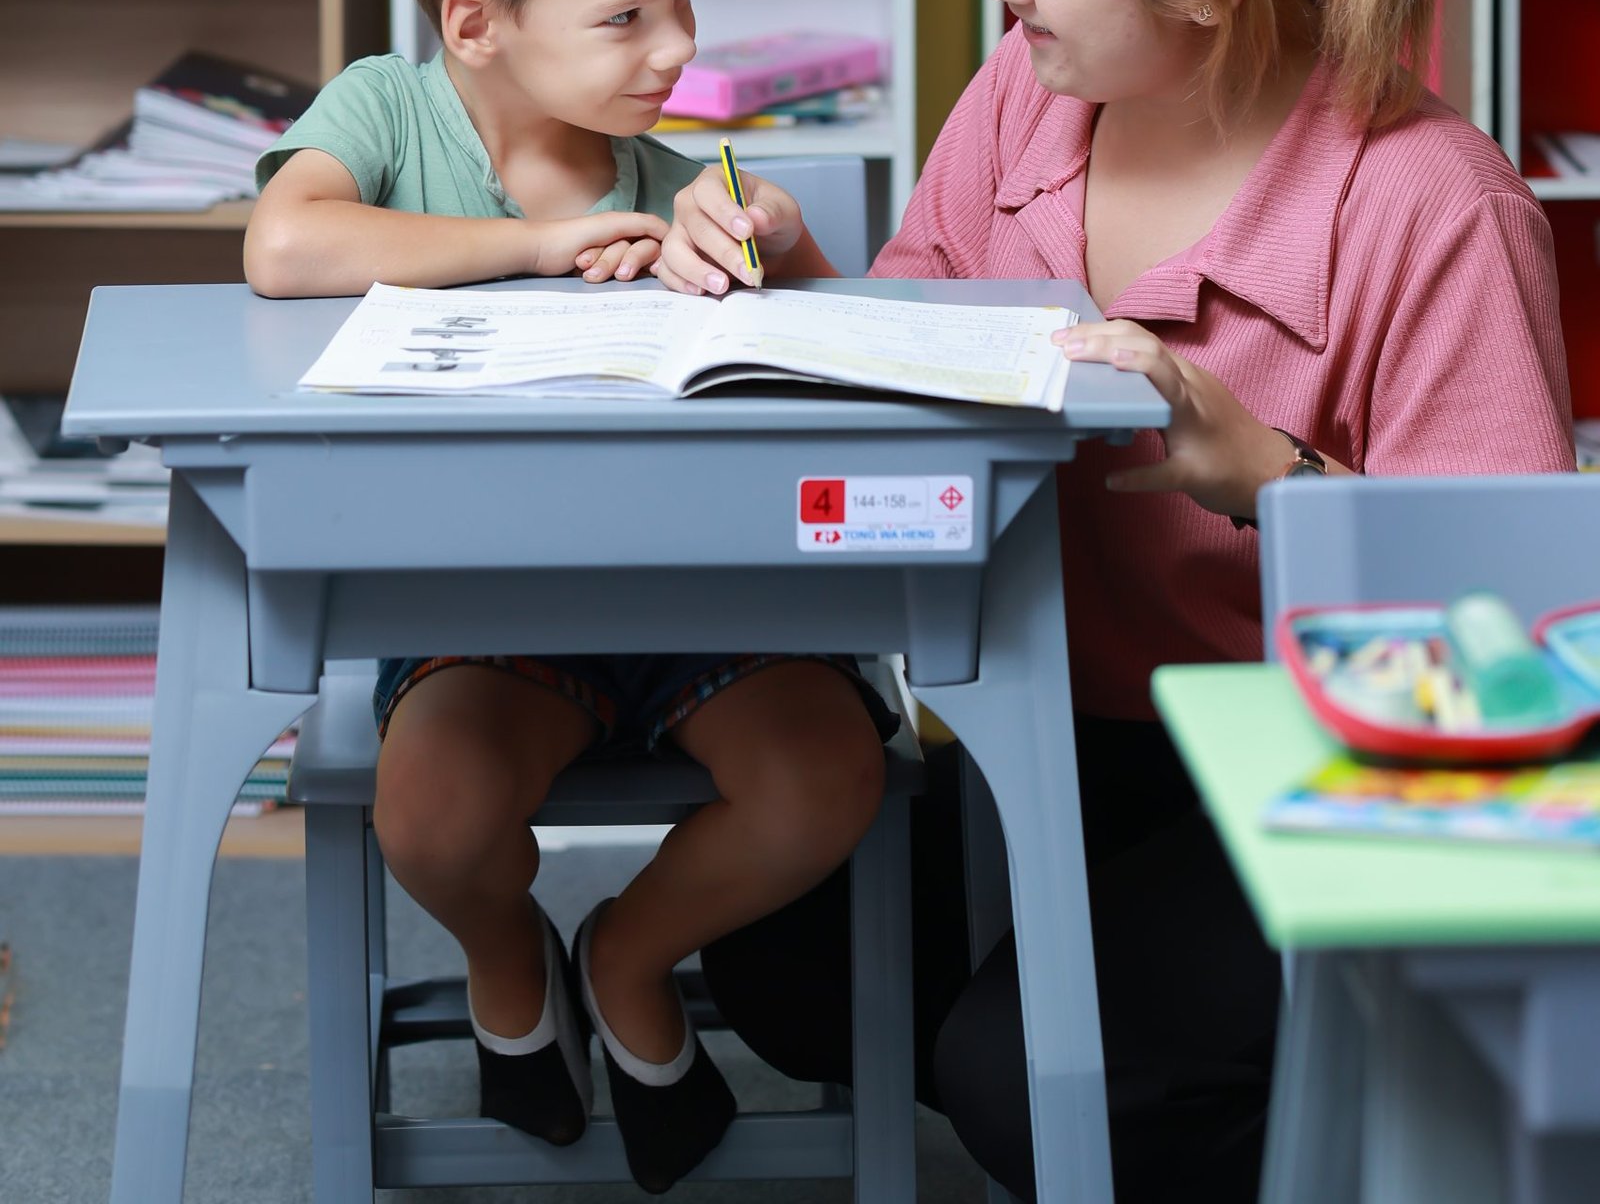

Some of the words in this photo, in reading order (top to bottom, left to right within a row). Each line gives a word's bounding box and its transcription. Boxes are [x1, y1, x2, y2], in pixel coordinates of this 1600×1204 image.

[812, 487, 833, 517] 4
[852, 494, 906, 509] 144-158
[844, 529, 876, 540] TONG
[880, 529, 900, 540] WA
[902, 529, 935, 540] HENG
